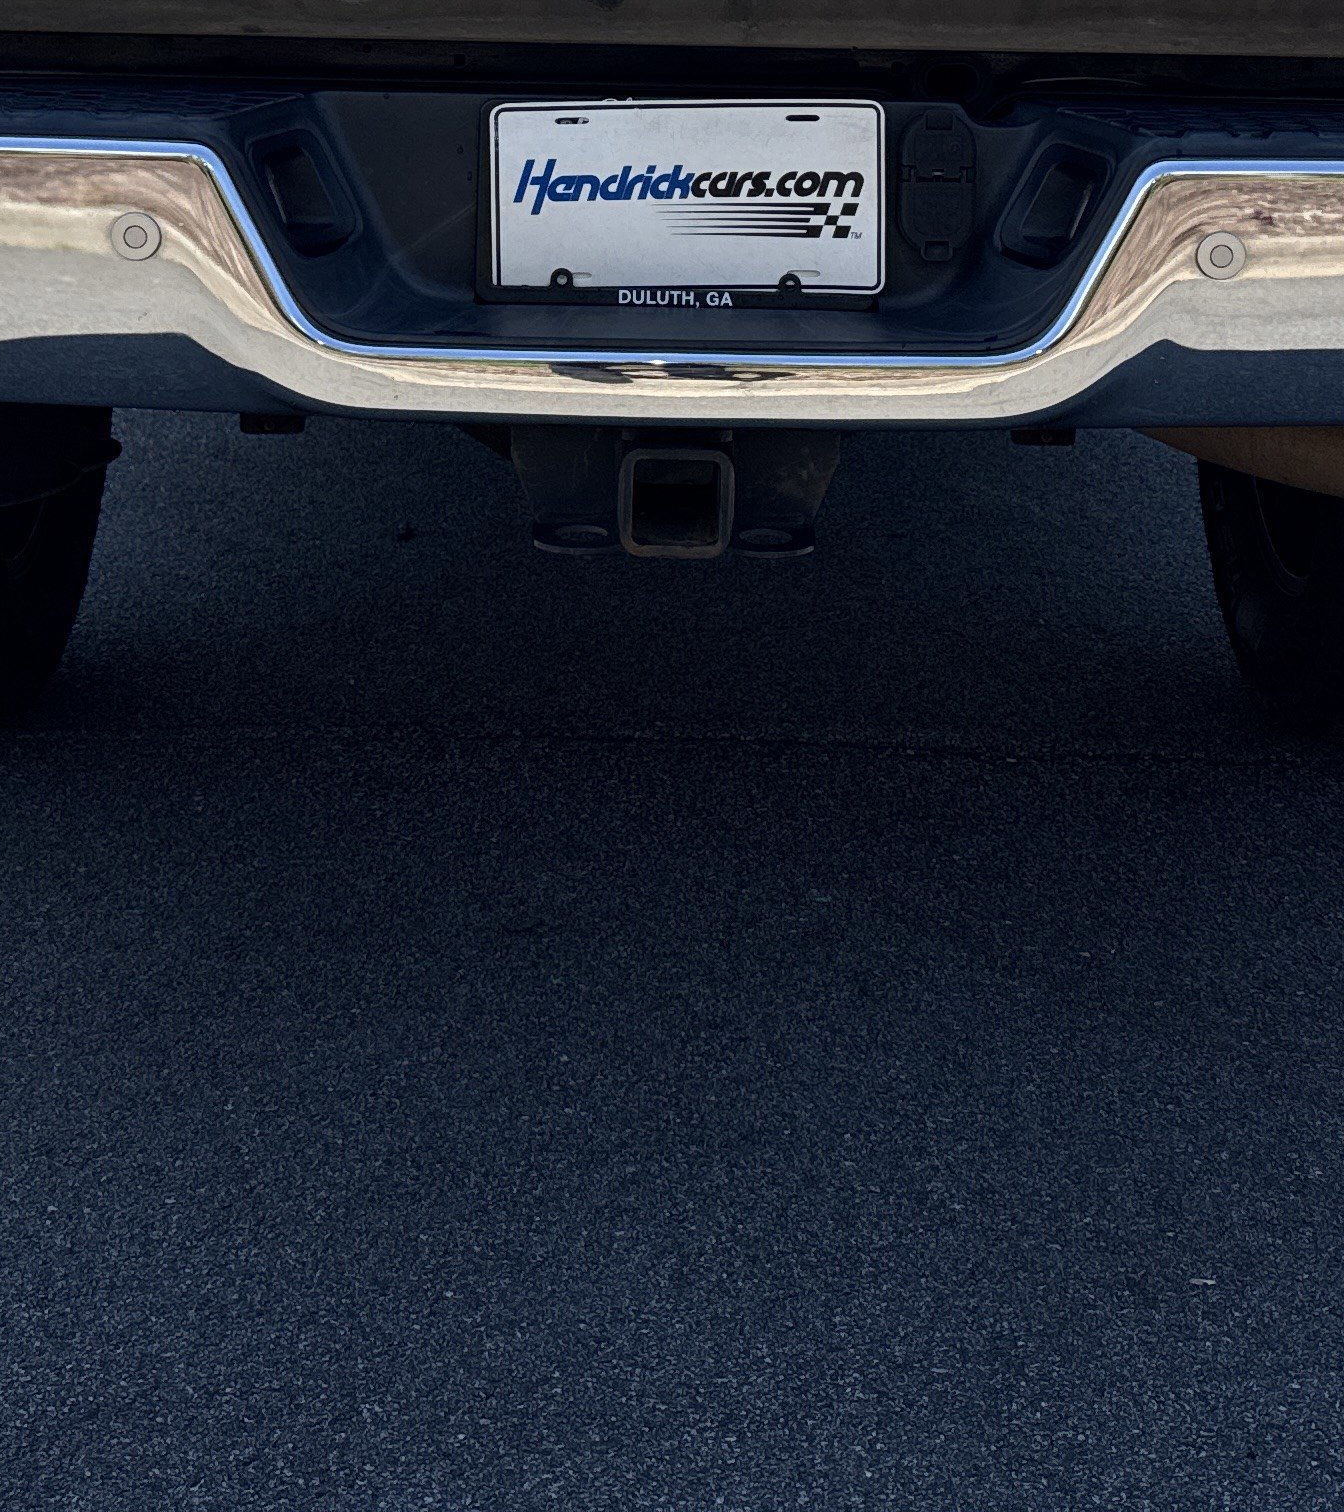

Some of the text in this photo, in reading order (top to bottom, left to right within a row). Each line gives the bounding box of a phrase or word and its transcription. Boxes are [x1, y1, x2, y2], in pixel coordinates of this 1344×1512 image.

[513, 159, 865, 215] Hendrickcars.com
[618, 289, 733, 309] DULUTH, GA
